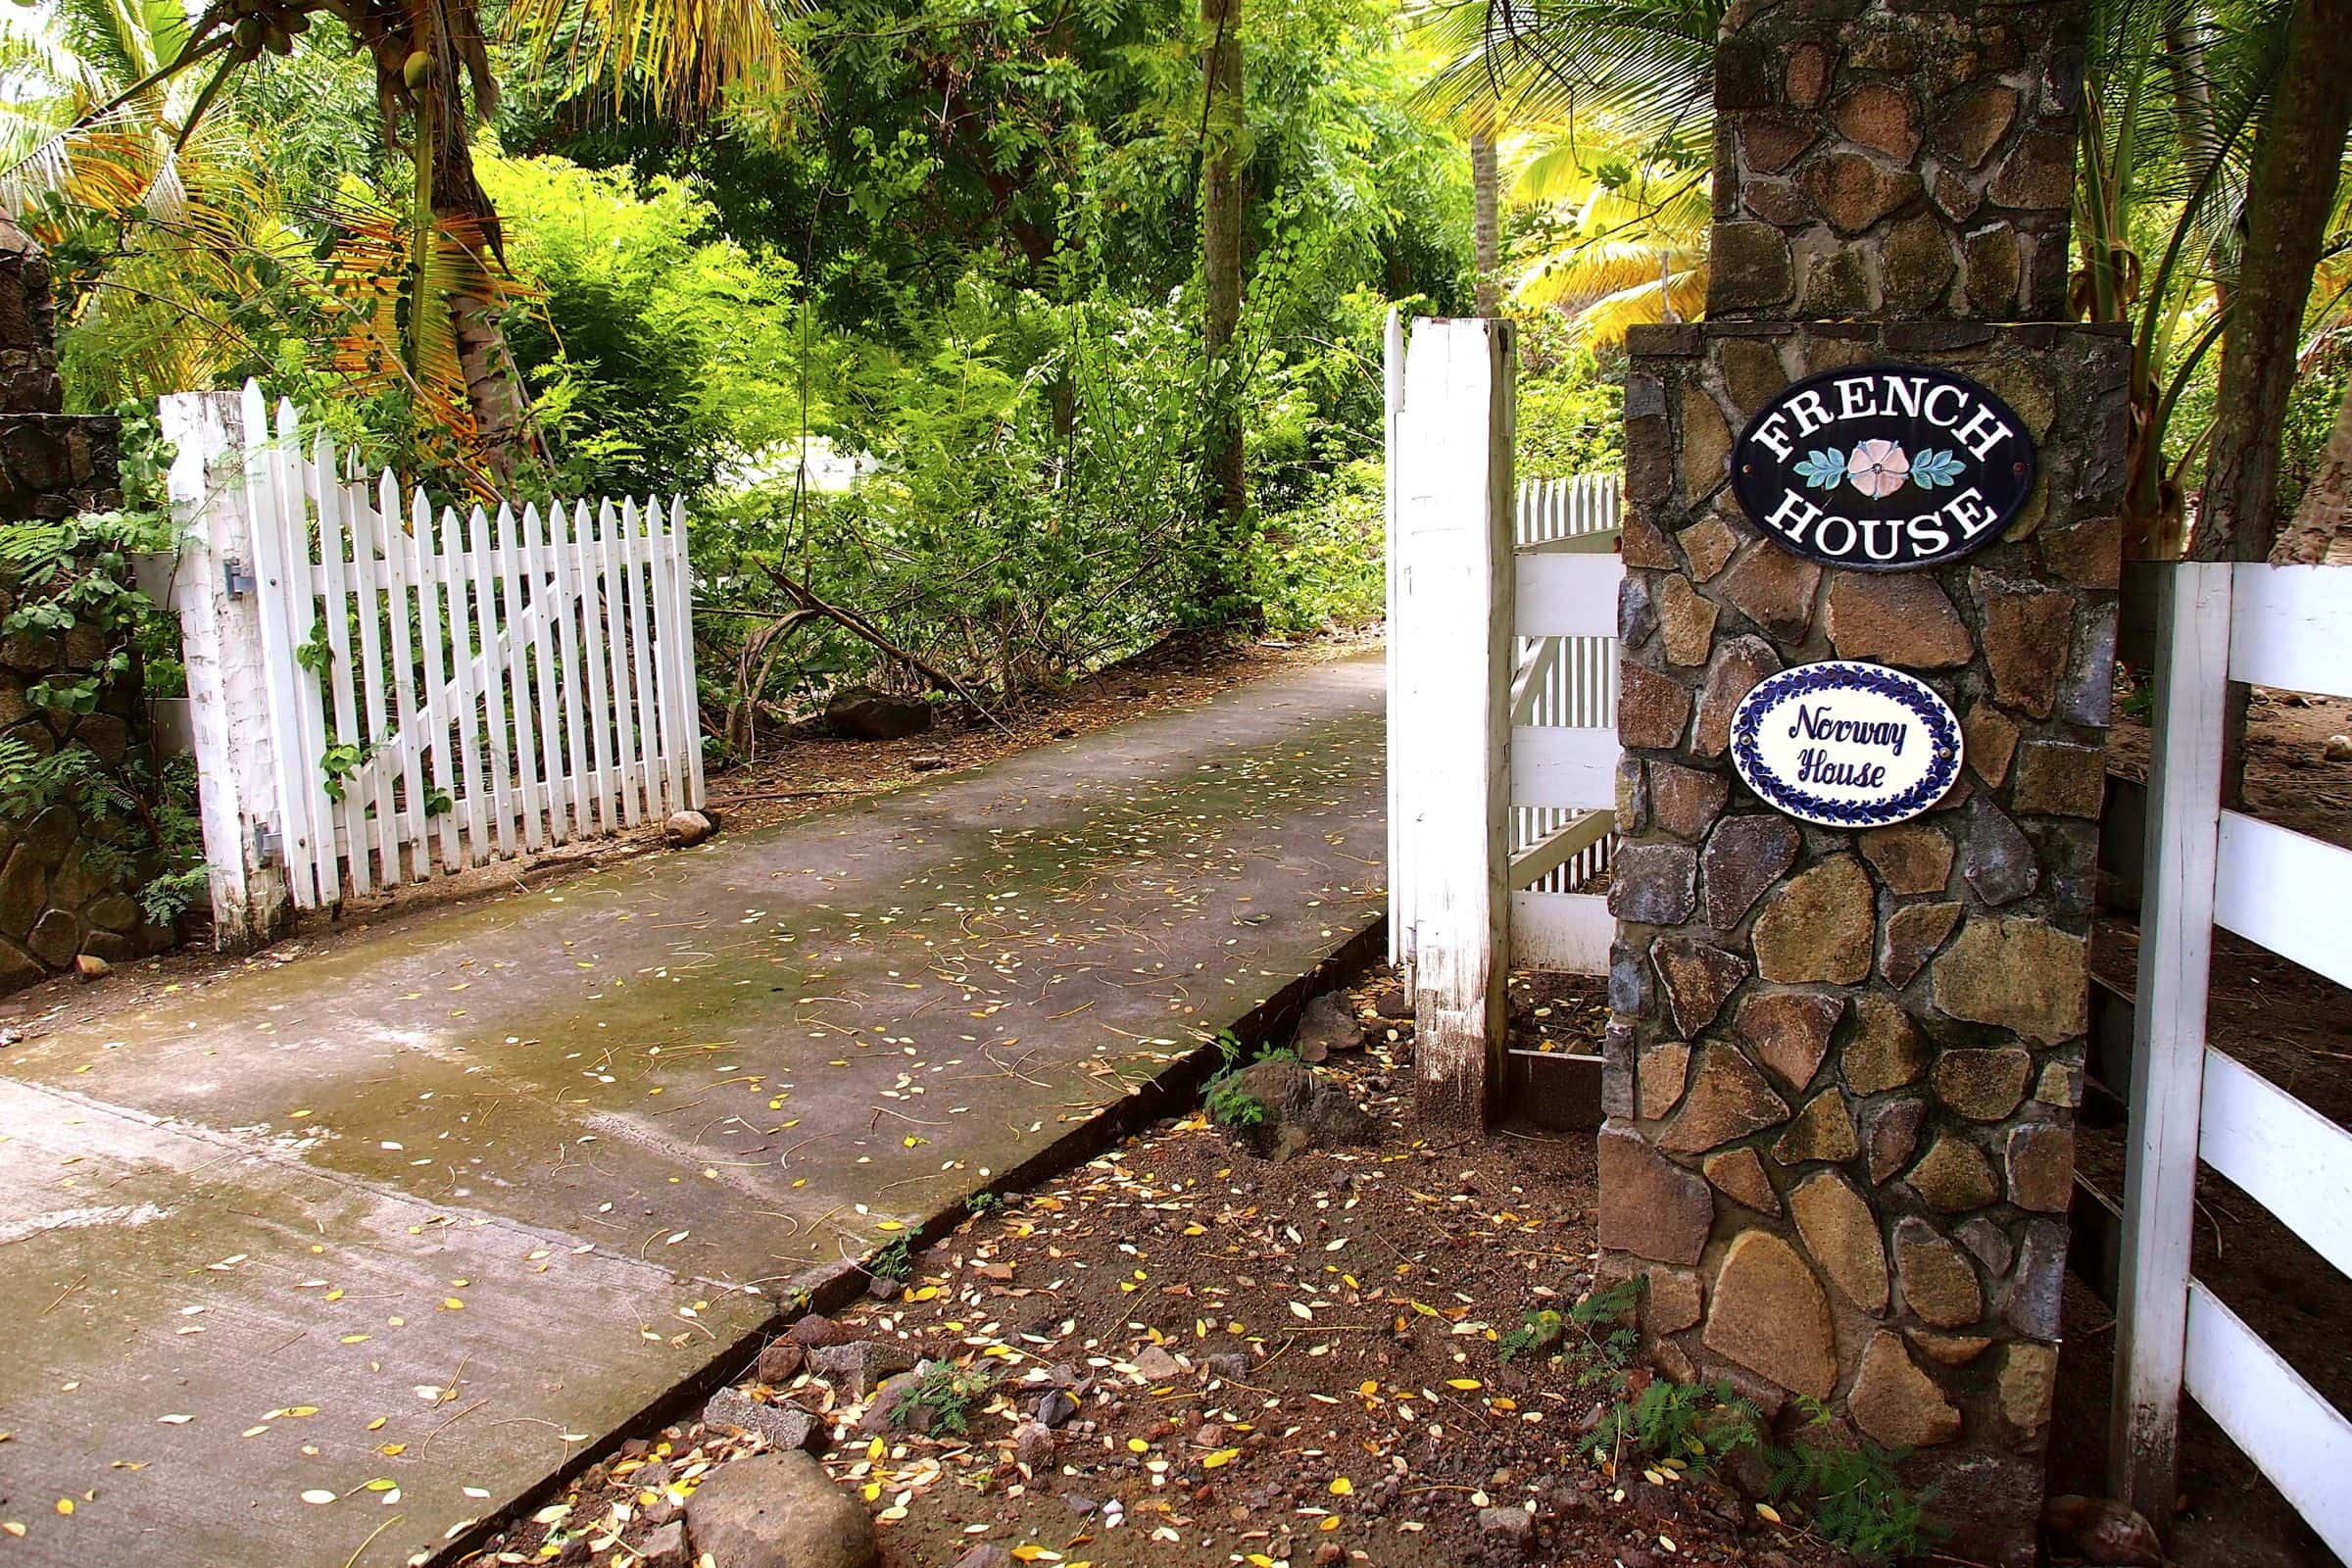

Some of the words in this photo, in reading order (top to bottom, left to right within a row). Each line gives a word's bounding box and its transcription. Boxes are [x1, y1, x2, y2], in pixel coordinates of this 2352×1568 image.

[1749, 375, 2014, 464] FRENCH
[1764, 486, 1998, 560] HOUSE
[1788, 704, 1908, 757] Norway
[1796, 748, 1886, 788] House
